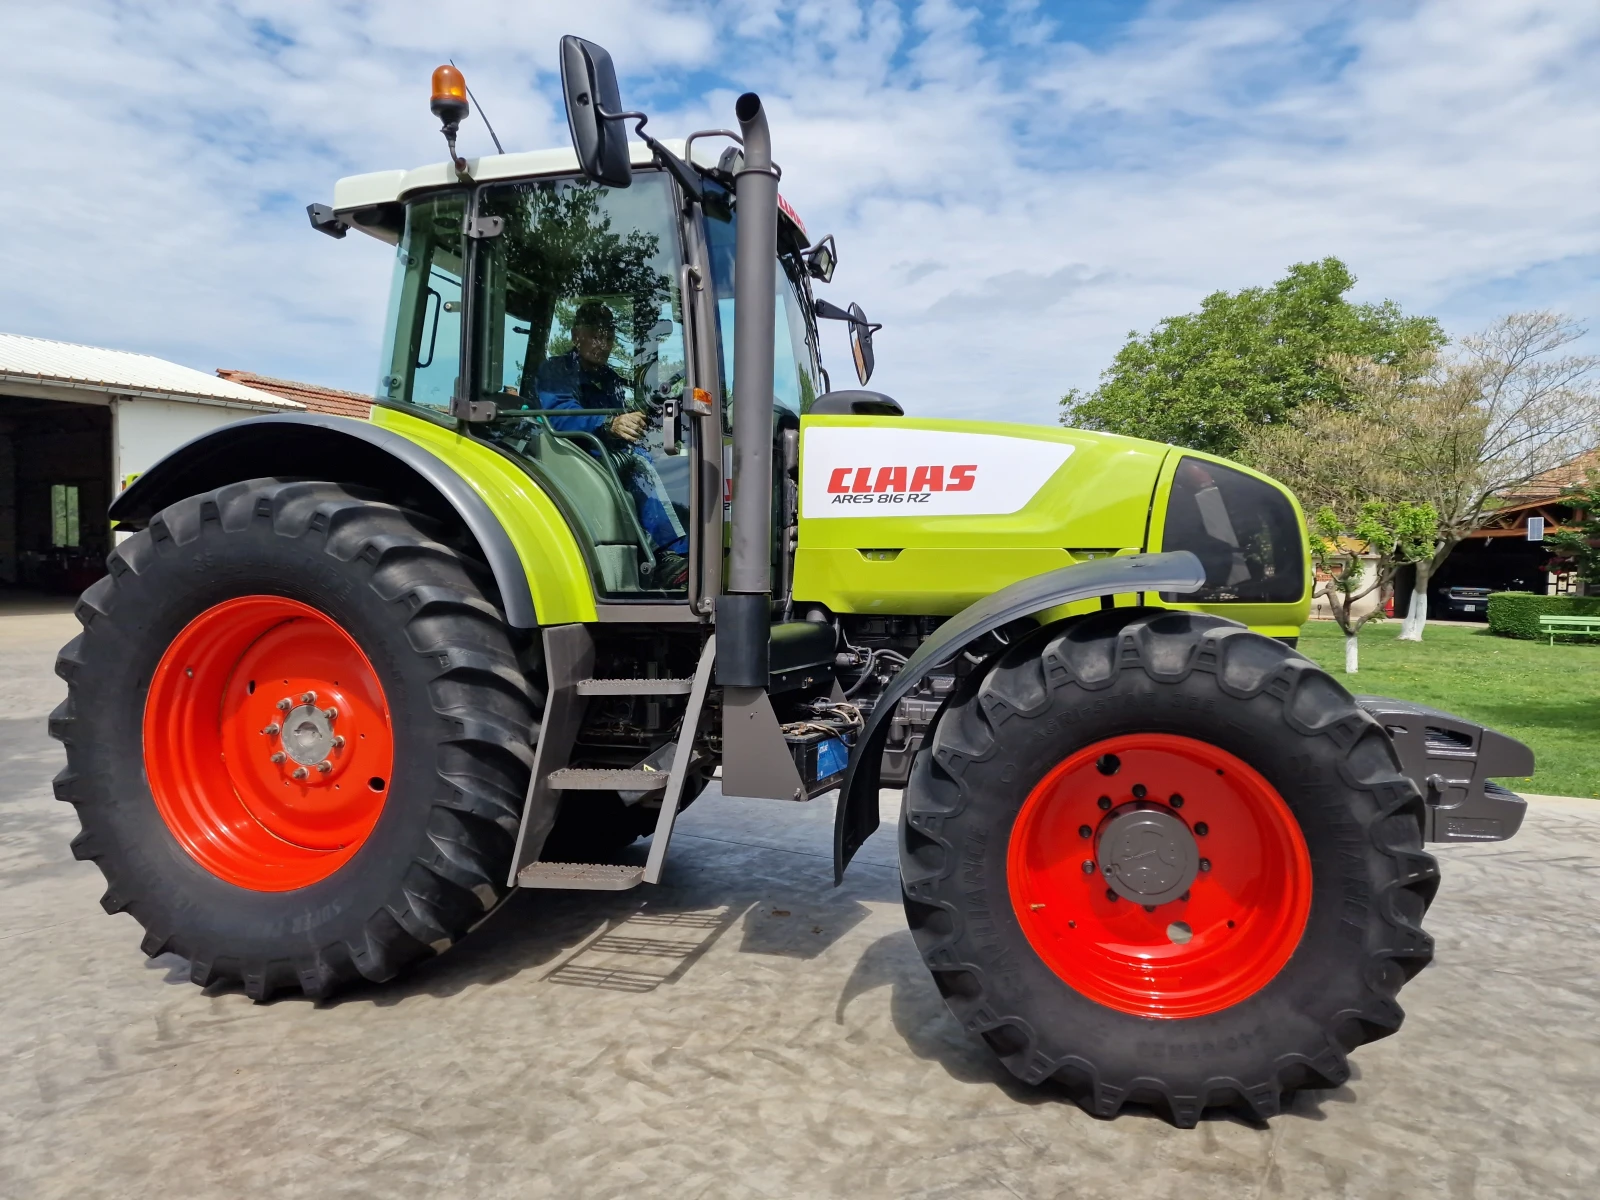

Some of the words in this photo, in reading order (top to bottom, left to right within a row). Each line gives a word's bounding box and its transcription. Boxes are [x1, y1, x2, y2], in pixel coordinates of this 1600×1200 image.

[827, 464, 978, 494] CLAAS
[831, 494, 874, 504] ARES
[877, 493, 905, 504] 816
[906, 492, 932, 503] RZ
